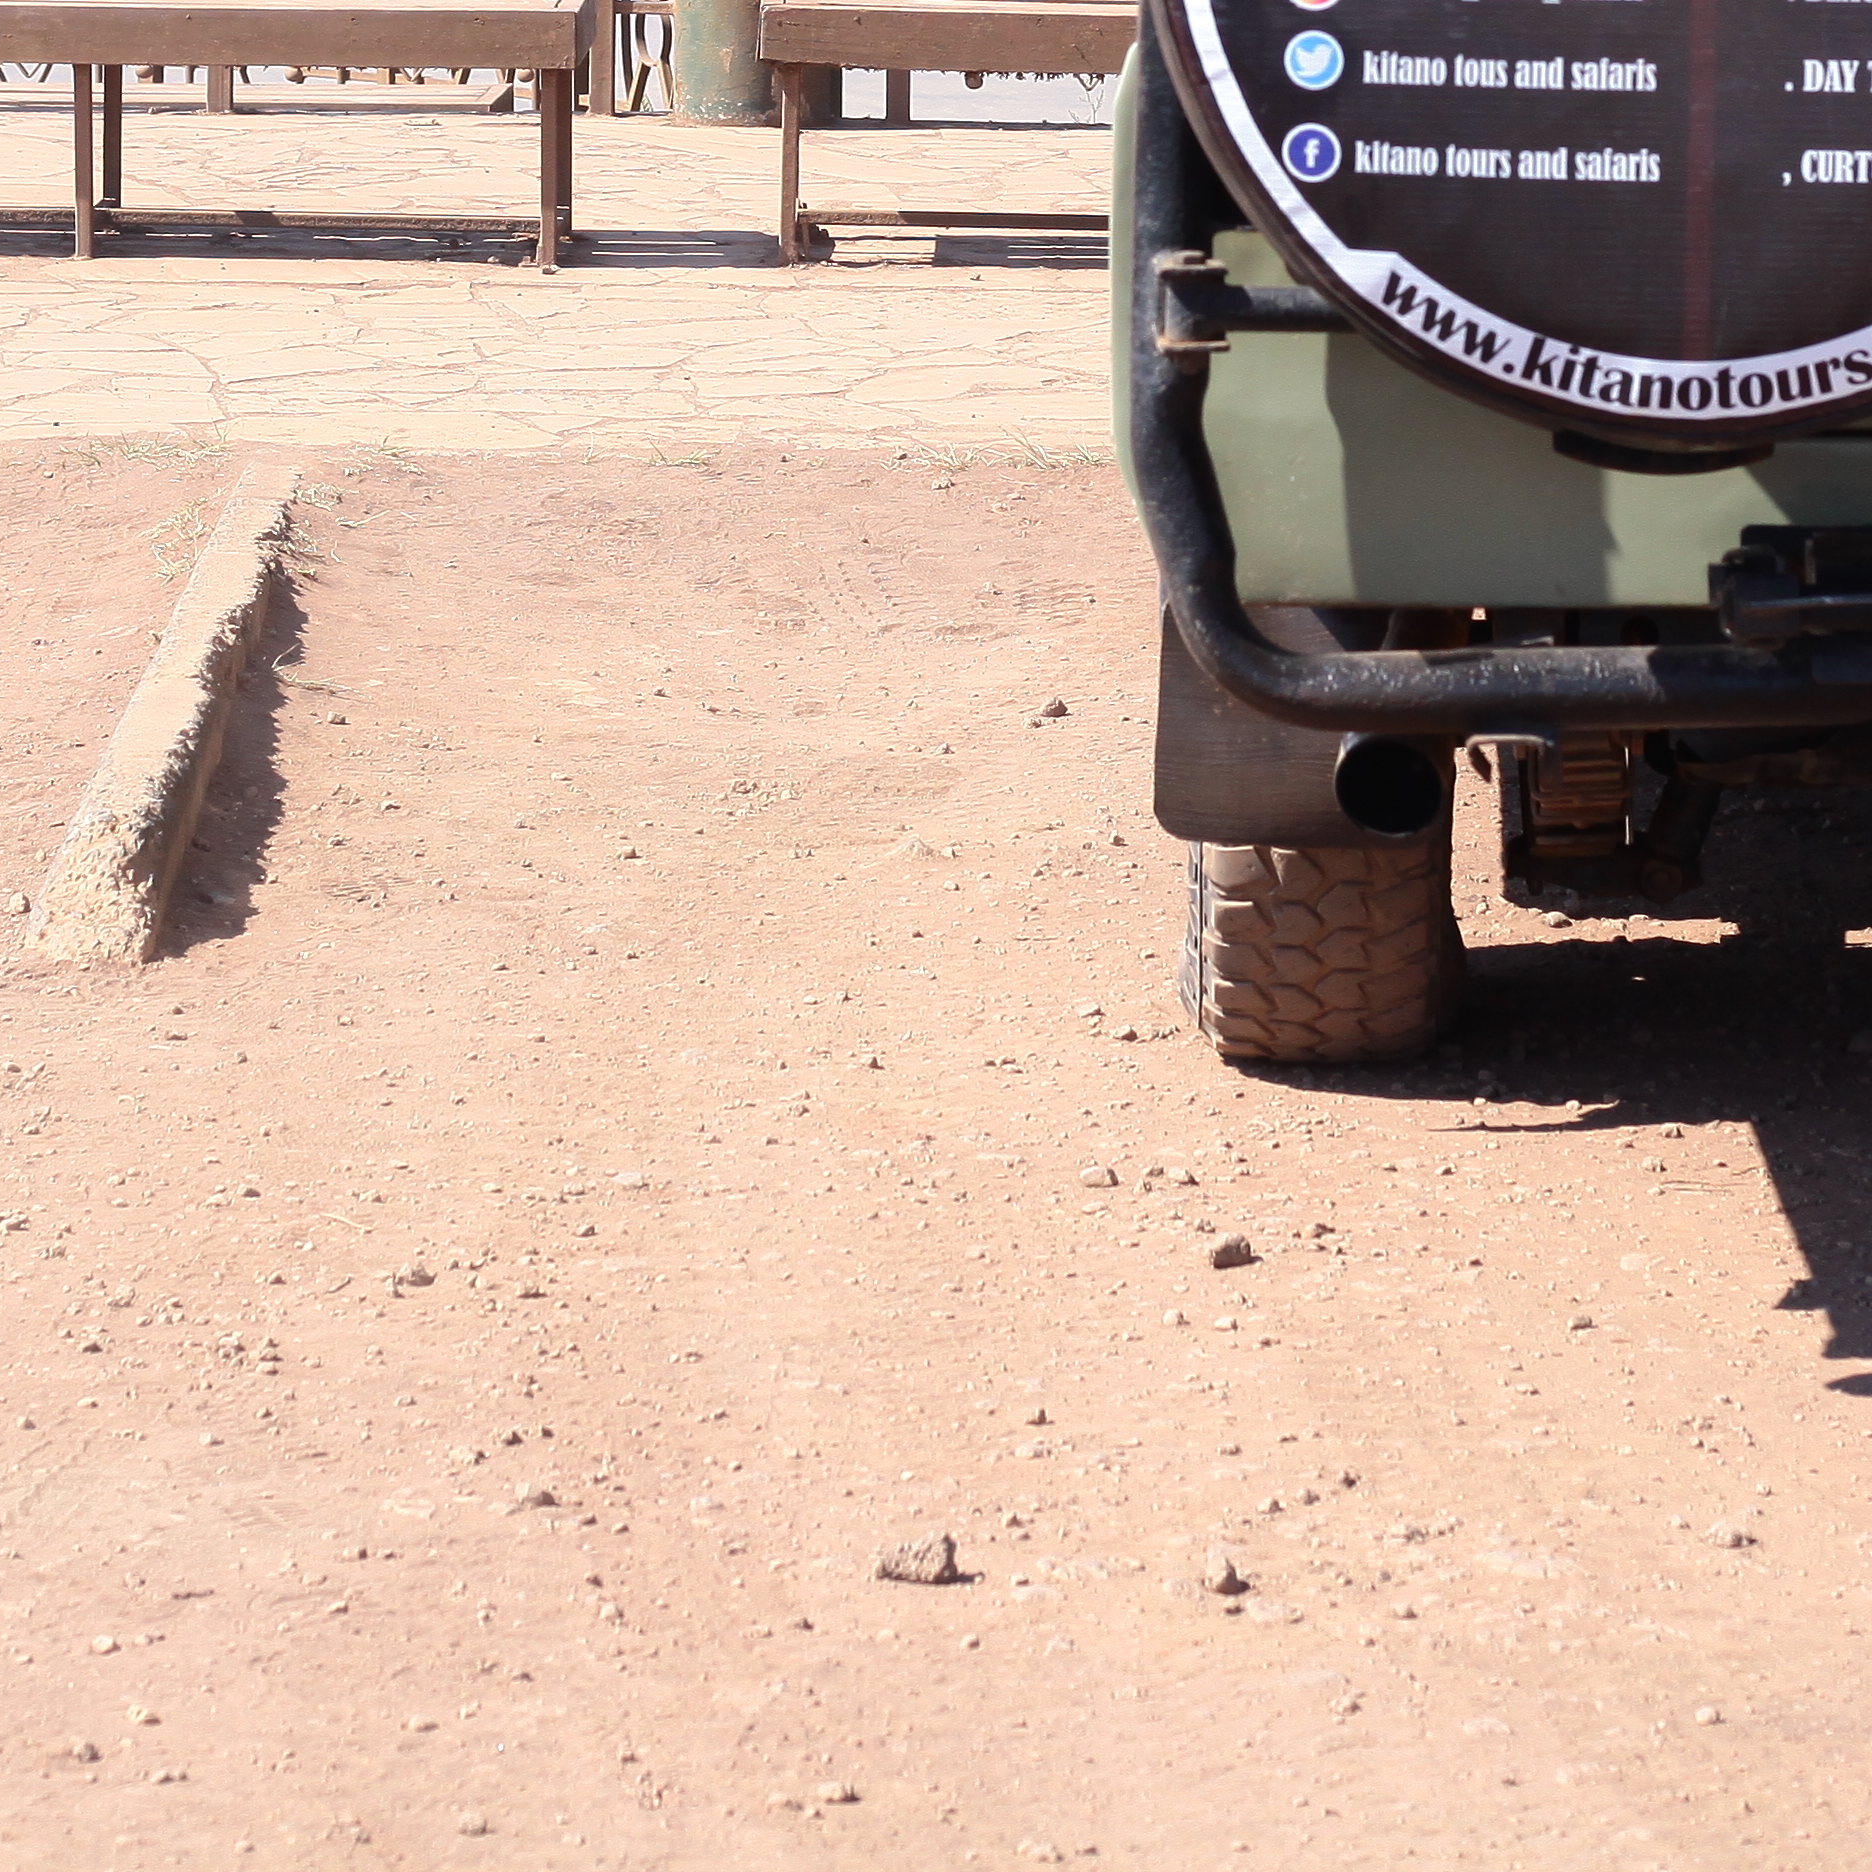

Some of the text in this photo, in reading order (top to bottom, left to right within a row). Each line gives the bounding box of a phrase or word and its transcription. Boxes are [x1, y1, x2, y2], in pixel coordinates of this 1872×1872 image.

[1362, 49, 1658, 92] kitano tous and safaris
[1802, 59, 1860, 93] DAY
[1354, 140, 1661, 182] kitano tours and safaris
